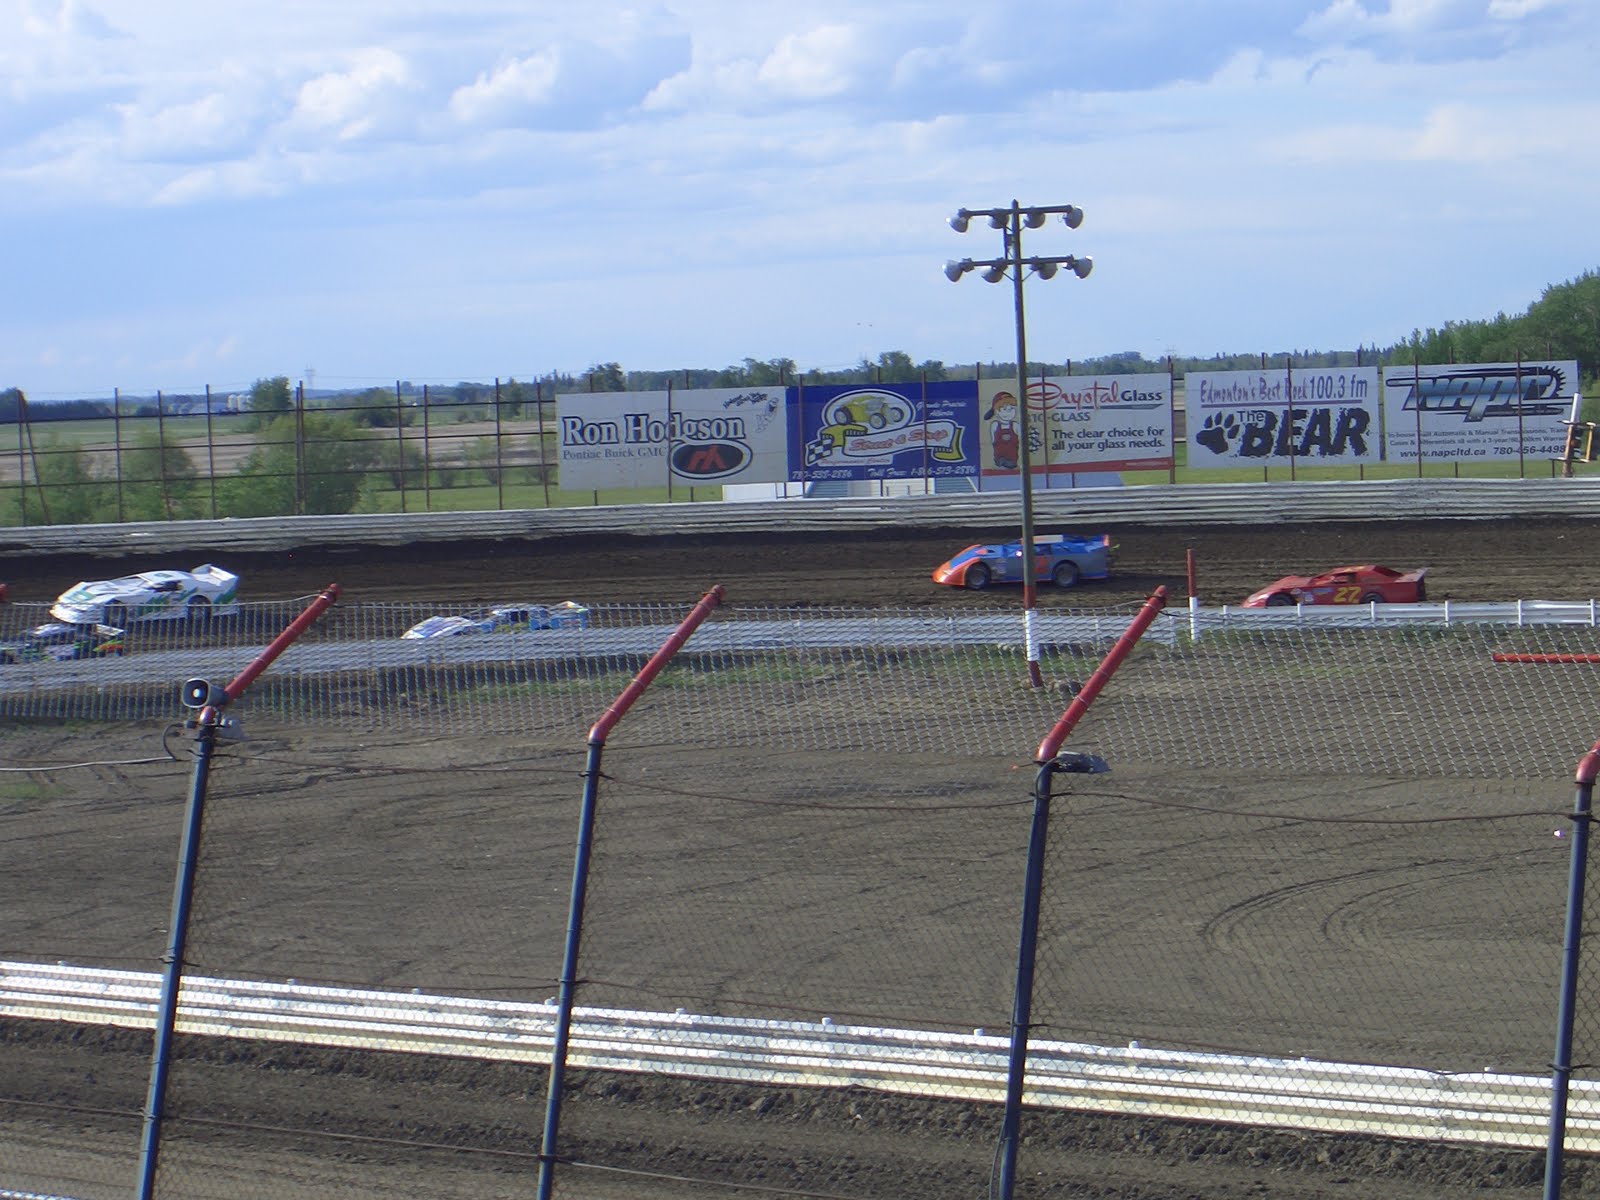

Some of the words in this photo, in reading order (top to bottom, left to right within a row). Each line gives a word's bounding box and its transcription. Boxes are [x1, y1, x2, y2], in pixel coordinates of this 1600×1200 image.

[1026, 380, 1119, 411] Crystal
[1120, 389, 1163, 402] Glass
[1200, 376, 1256, 403] Edmonton's
[1258, 376, 1281, 402] Best
[1309, 374, 1345, 400] 100.3
[1350, 373, 1368, 399] fm
[1236, 410, 1265, 424] The
[562, 416, 619, 446] Ron
[624, 411, 746, 444] Hodgson
[1051, 429, 1075, 439] The
[1076, 428, 1105, 439] clear
[1107, 426, 1144, 438] choice
[1147, 425, 1165, 437] for
[1238, 407, 1371, 457] BEAR
[563, 449, 601, 460] Pontiac
[604, 448, 634, 458] Buick
[637, 446, 667, 457] GMC
[1051, 440, 1065, 451] all
[1067, 442, 1095, 453] your
[1098, 440, 1126, 453] glass
[1128, 437, 1166, 448] needs.
[1400, 447, 1486, 458] www.napcltd.ca
[1333, 586, 1362, 604] 27
